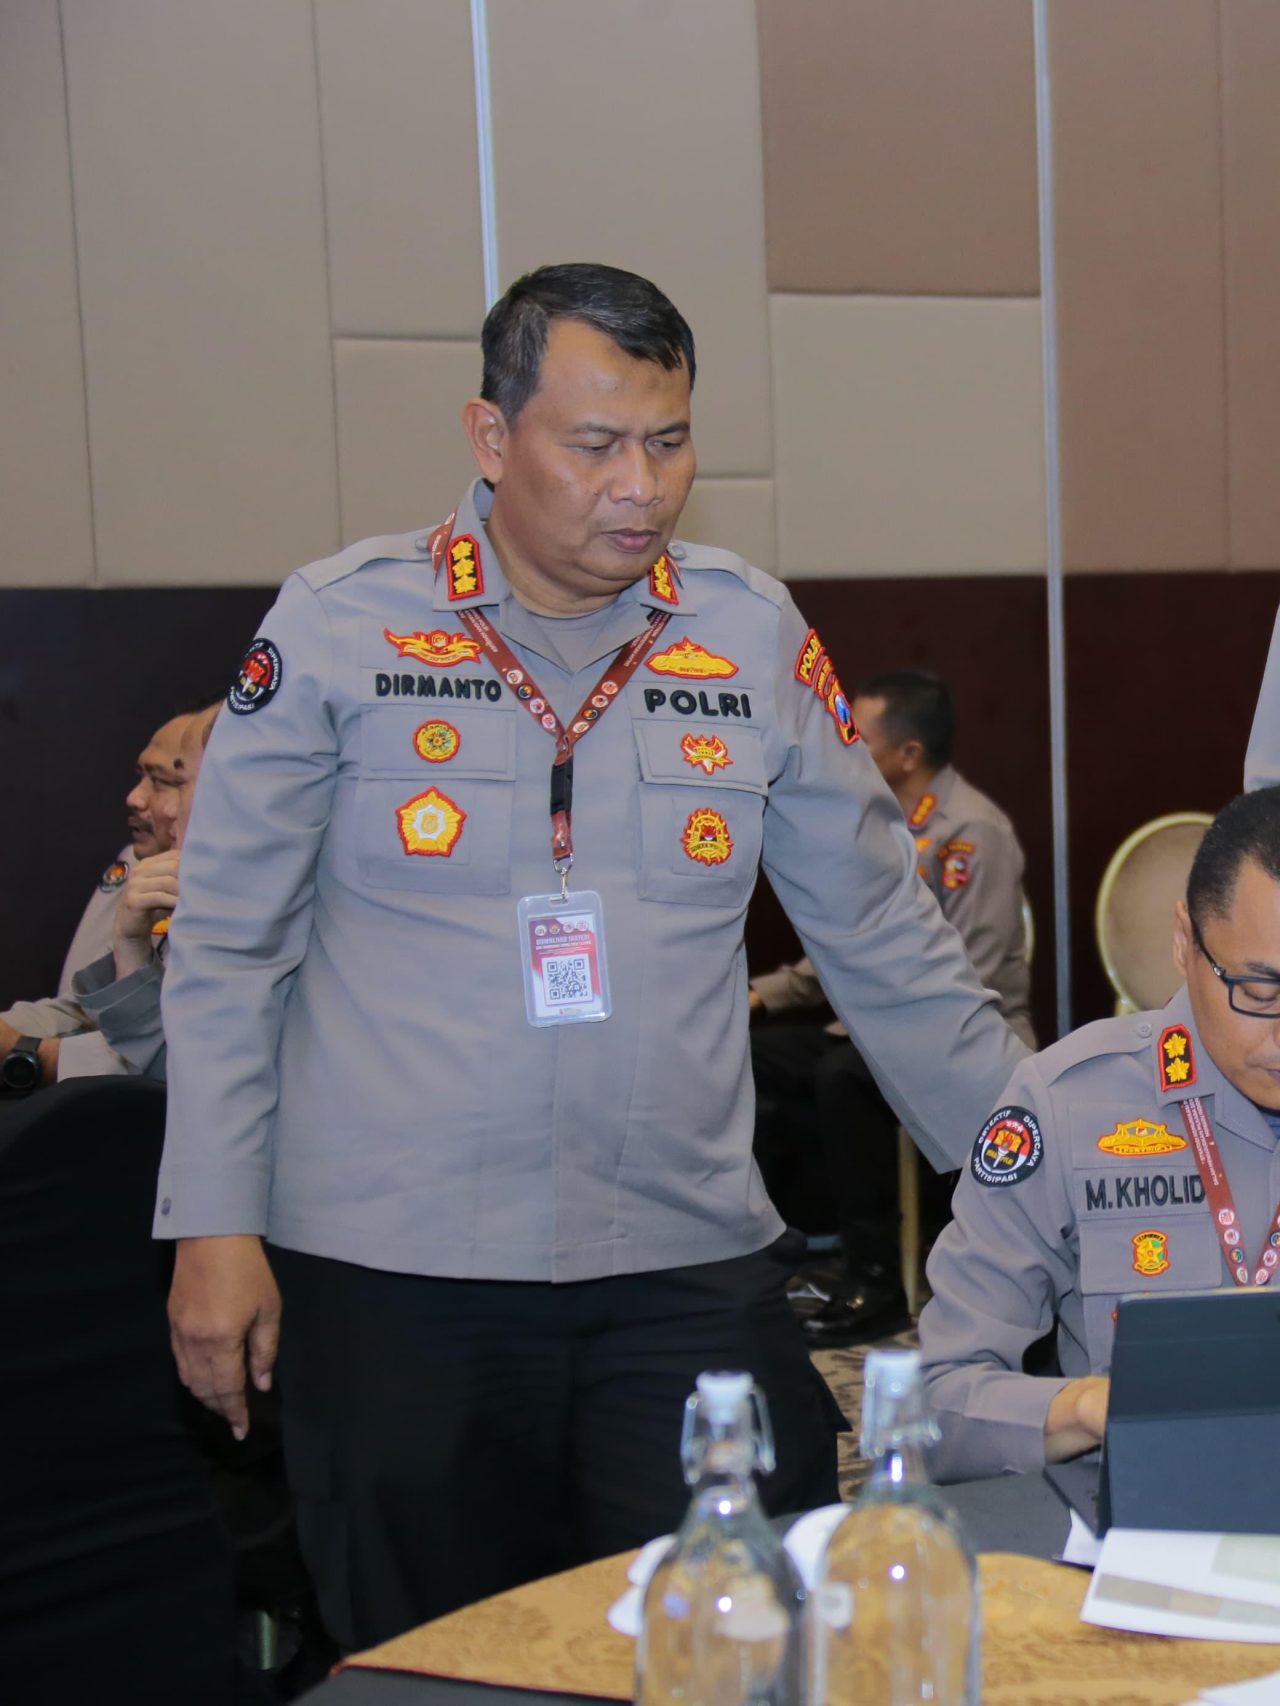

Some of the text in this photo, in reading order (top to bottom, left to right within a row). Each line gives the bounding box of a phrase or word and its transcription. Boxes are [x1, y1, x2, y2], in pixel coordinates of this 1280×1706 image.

[375, 673, 502, 702] DIRMANTO
[644, 689, 752, 719] POLRI
[1023, 1116, 1041, 1167] DIPERCAYA
[974, 1157, 1017, 1183] PARTISIPASI
[1085, 1175, 1206, 1211] M.KHOLID
